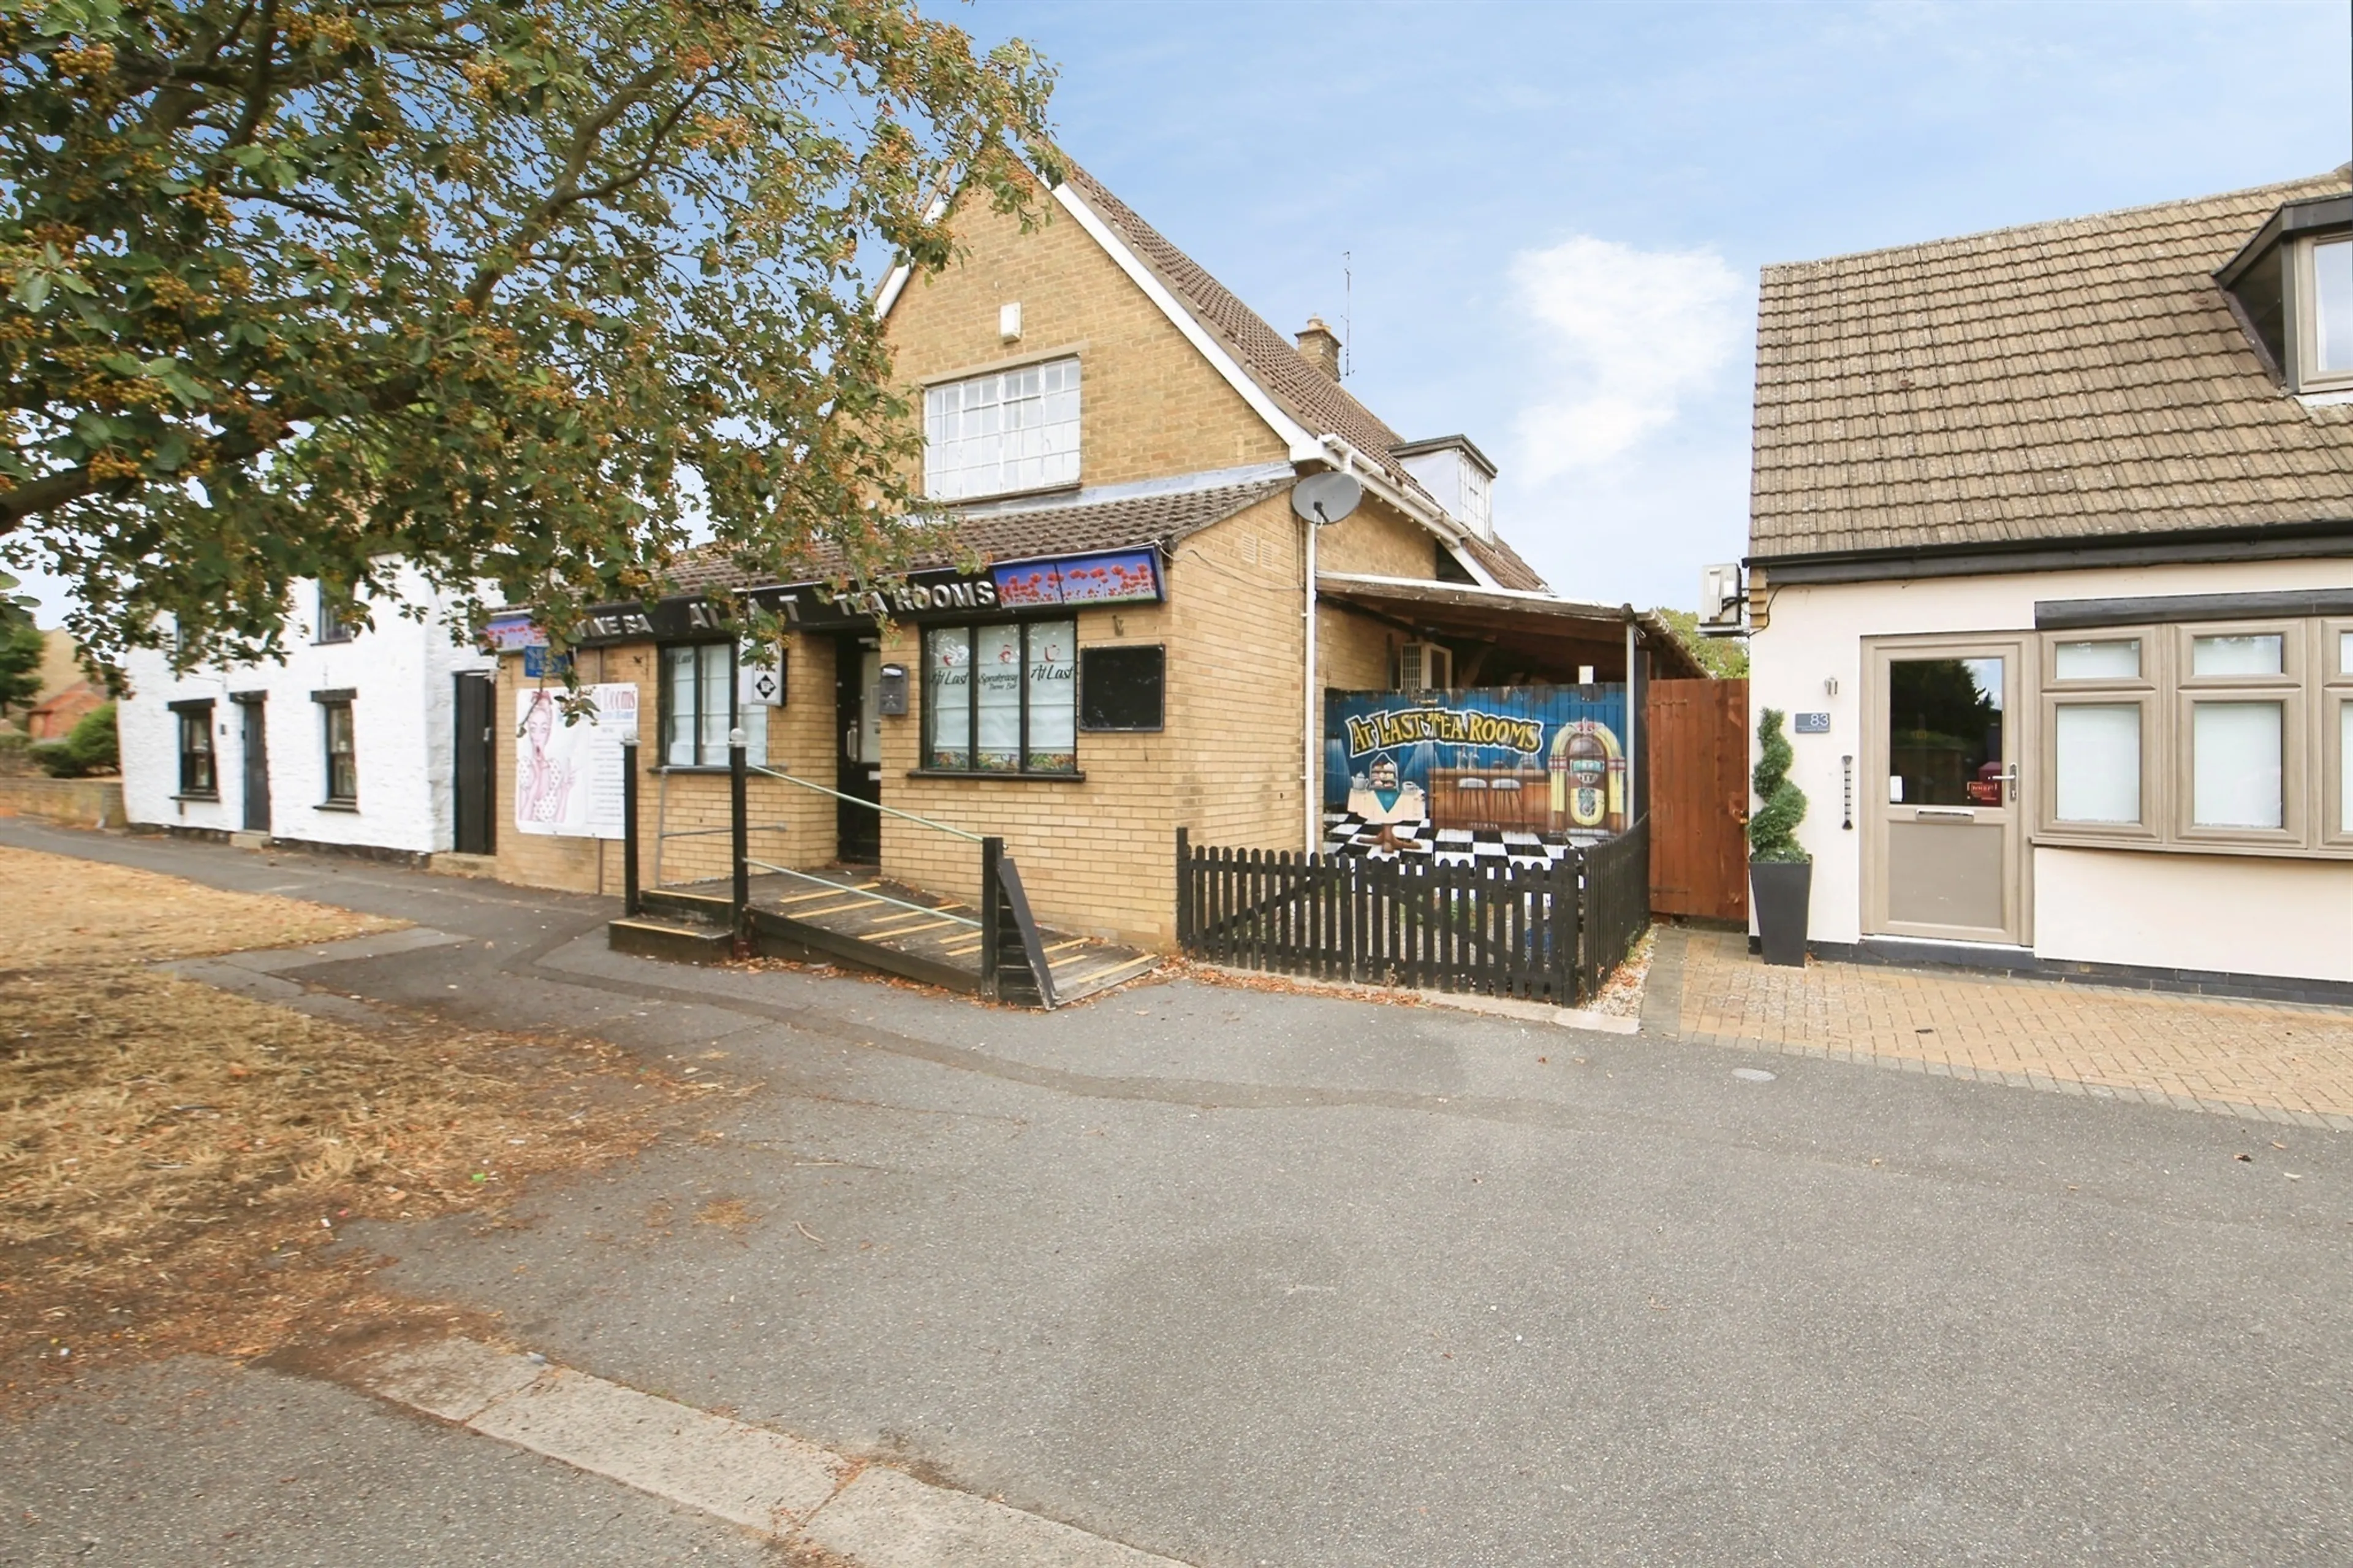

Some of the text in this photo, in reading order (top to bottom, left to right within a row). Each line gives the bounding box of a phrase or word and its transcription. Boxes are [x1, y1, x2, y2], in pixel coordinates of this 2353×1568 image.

[892, 581, 996, 612] ROOMS
[944, 670, 969, 685] Last
[1046, 664, 1073, 680] Last
[1810, 713, 1828, 726] 83
[1376, 714, 1423, 746] LAST
[1427, 712, 1464, 741] TEA
[1468, 713, 1539, 750] ROOMS
